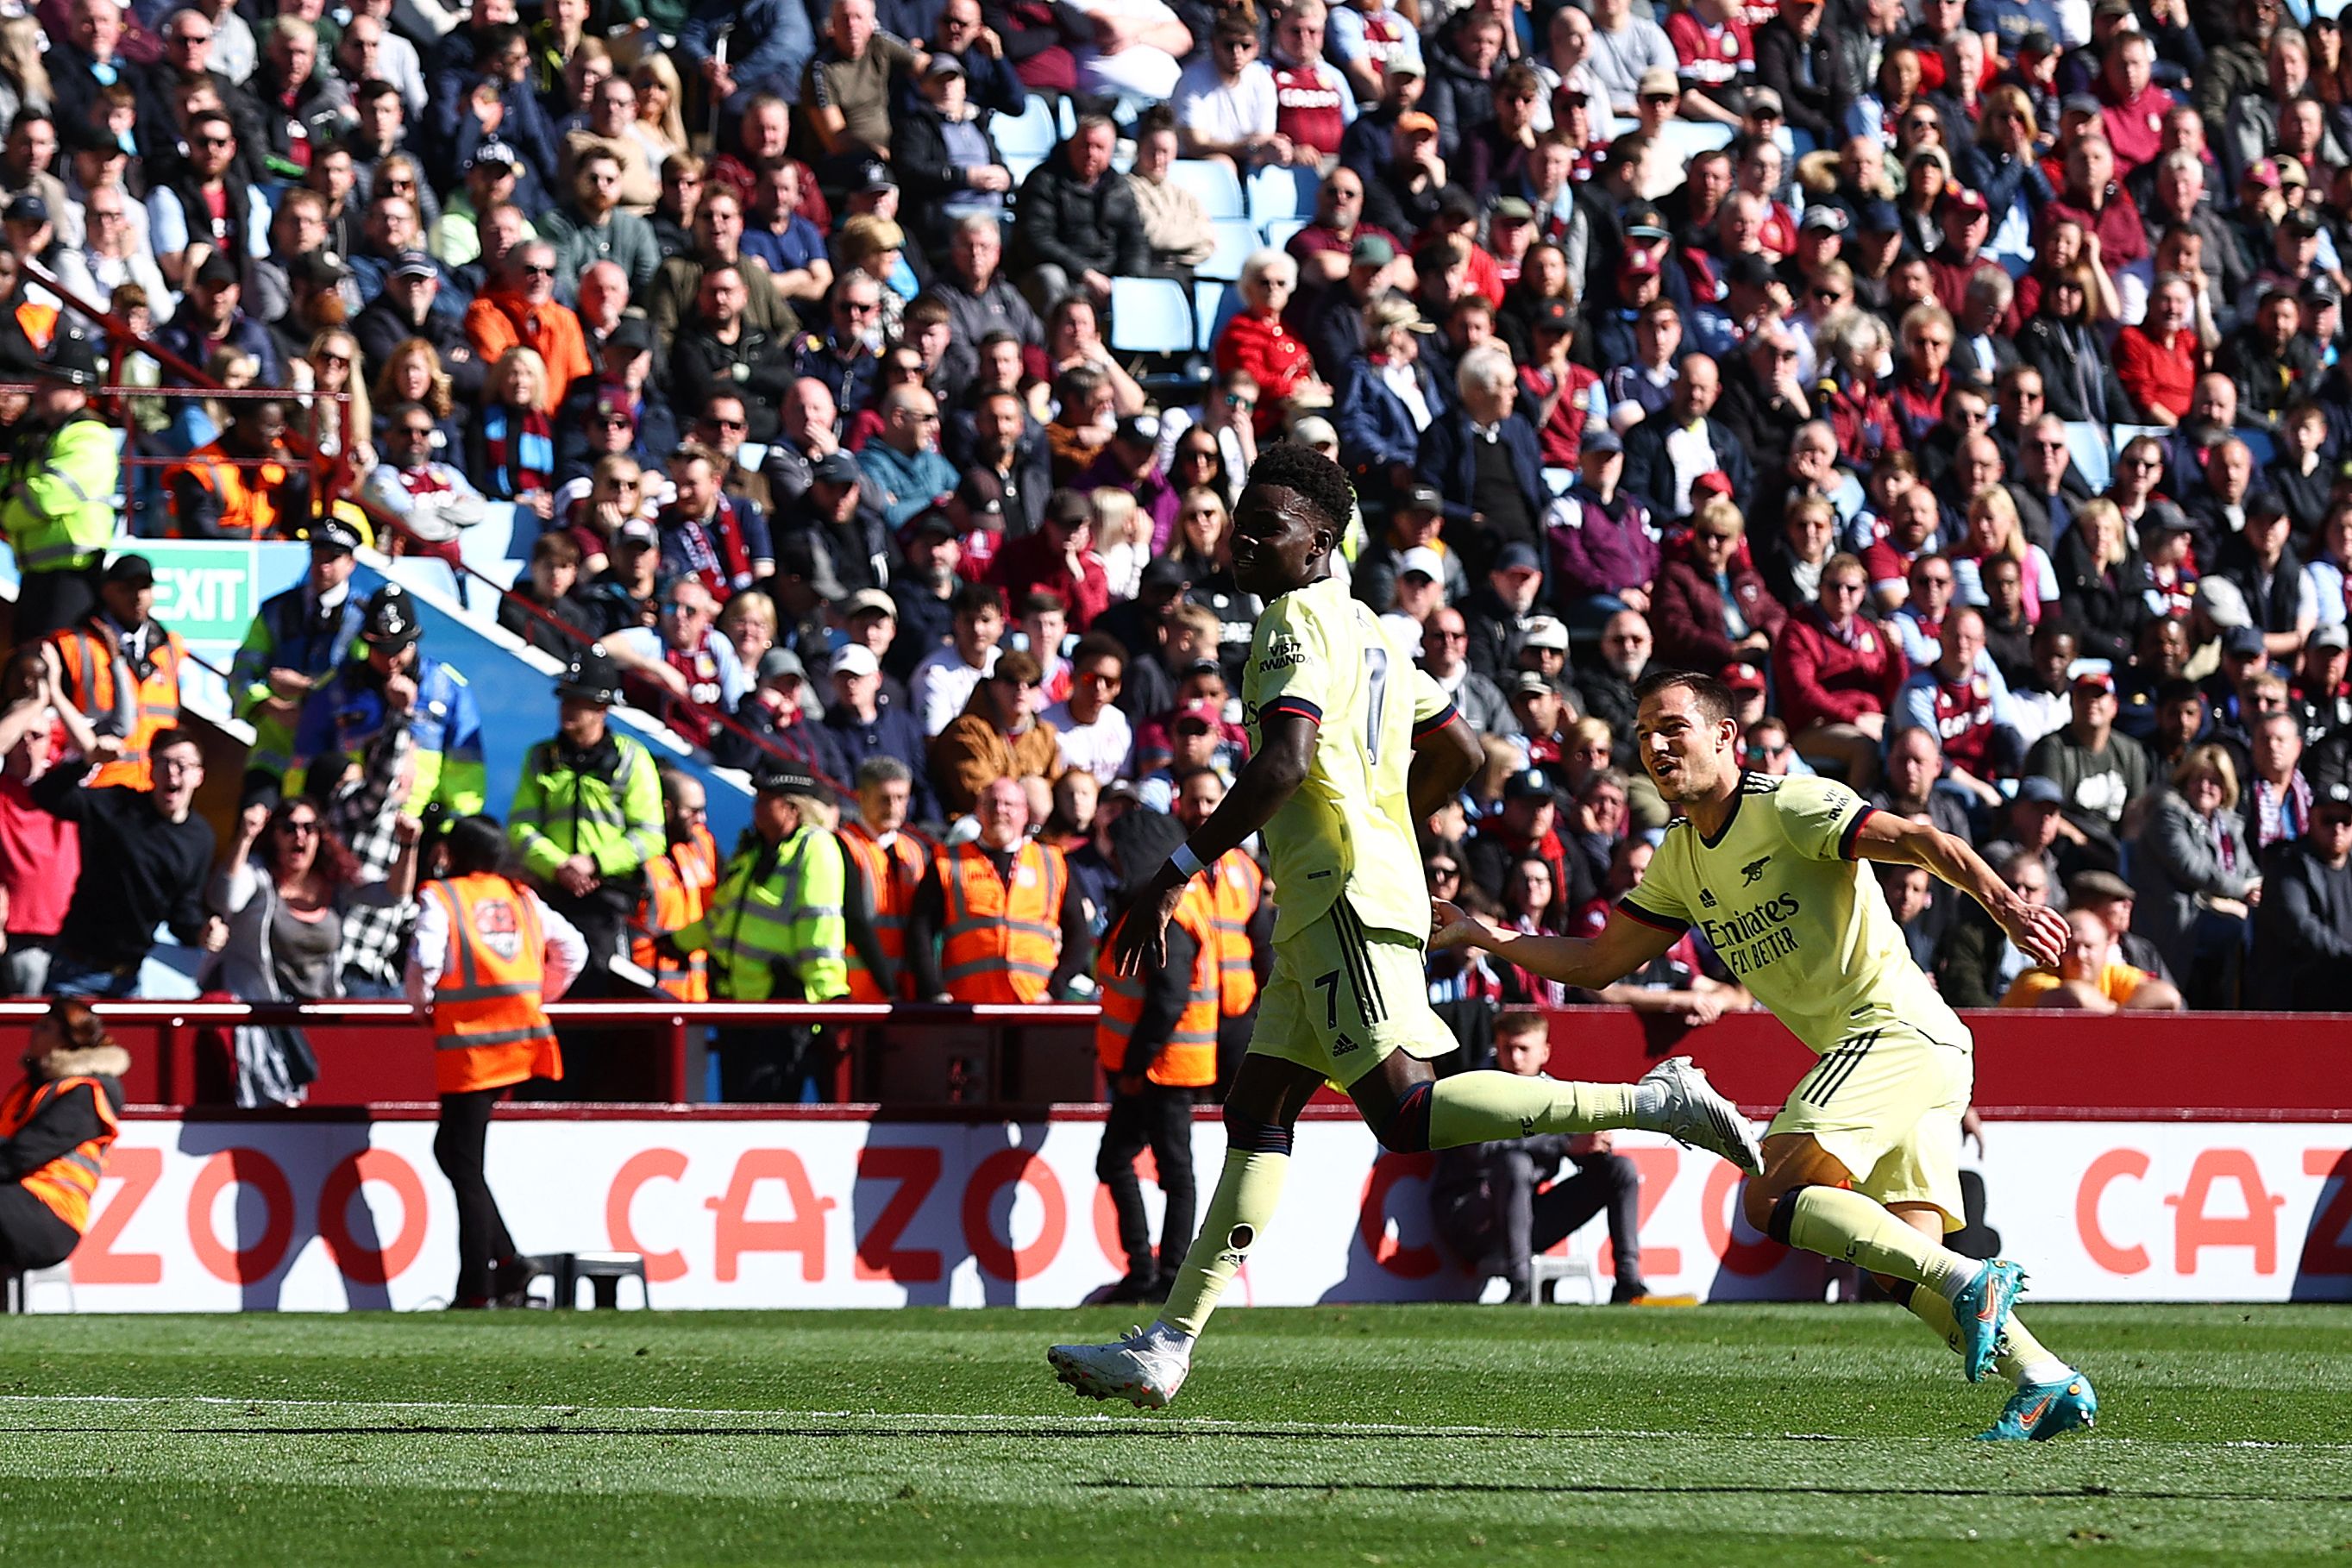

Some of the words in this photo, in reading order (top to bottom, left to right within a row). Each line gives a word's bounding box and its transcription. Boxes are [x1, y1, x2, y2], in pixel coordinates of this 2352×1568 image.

[149, 568, 246, 621] EXIT
[1259, 654, 1314, 674] RWANDA
[1270, 643, 1301, 657] VISIT
[1751, 926, 1800, 969] BETTER
[1314, 969, 1340, 1030] 7
[71, 1147, 429, 1285] ZOO
[2075, 1148, 2352, 1276] CAZ
